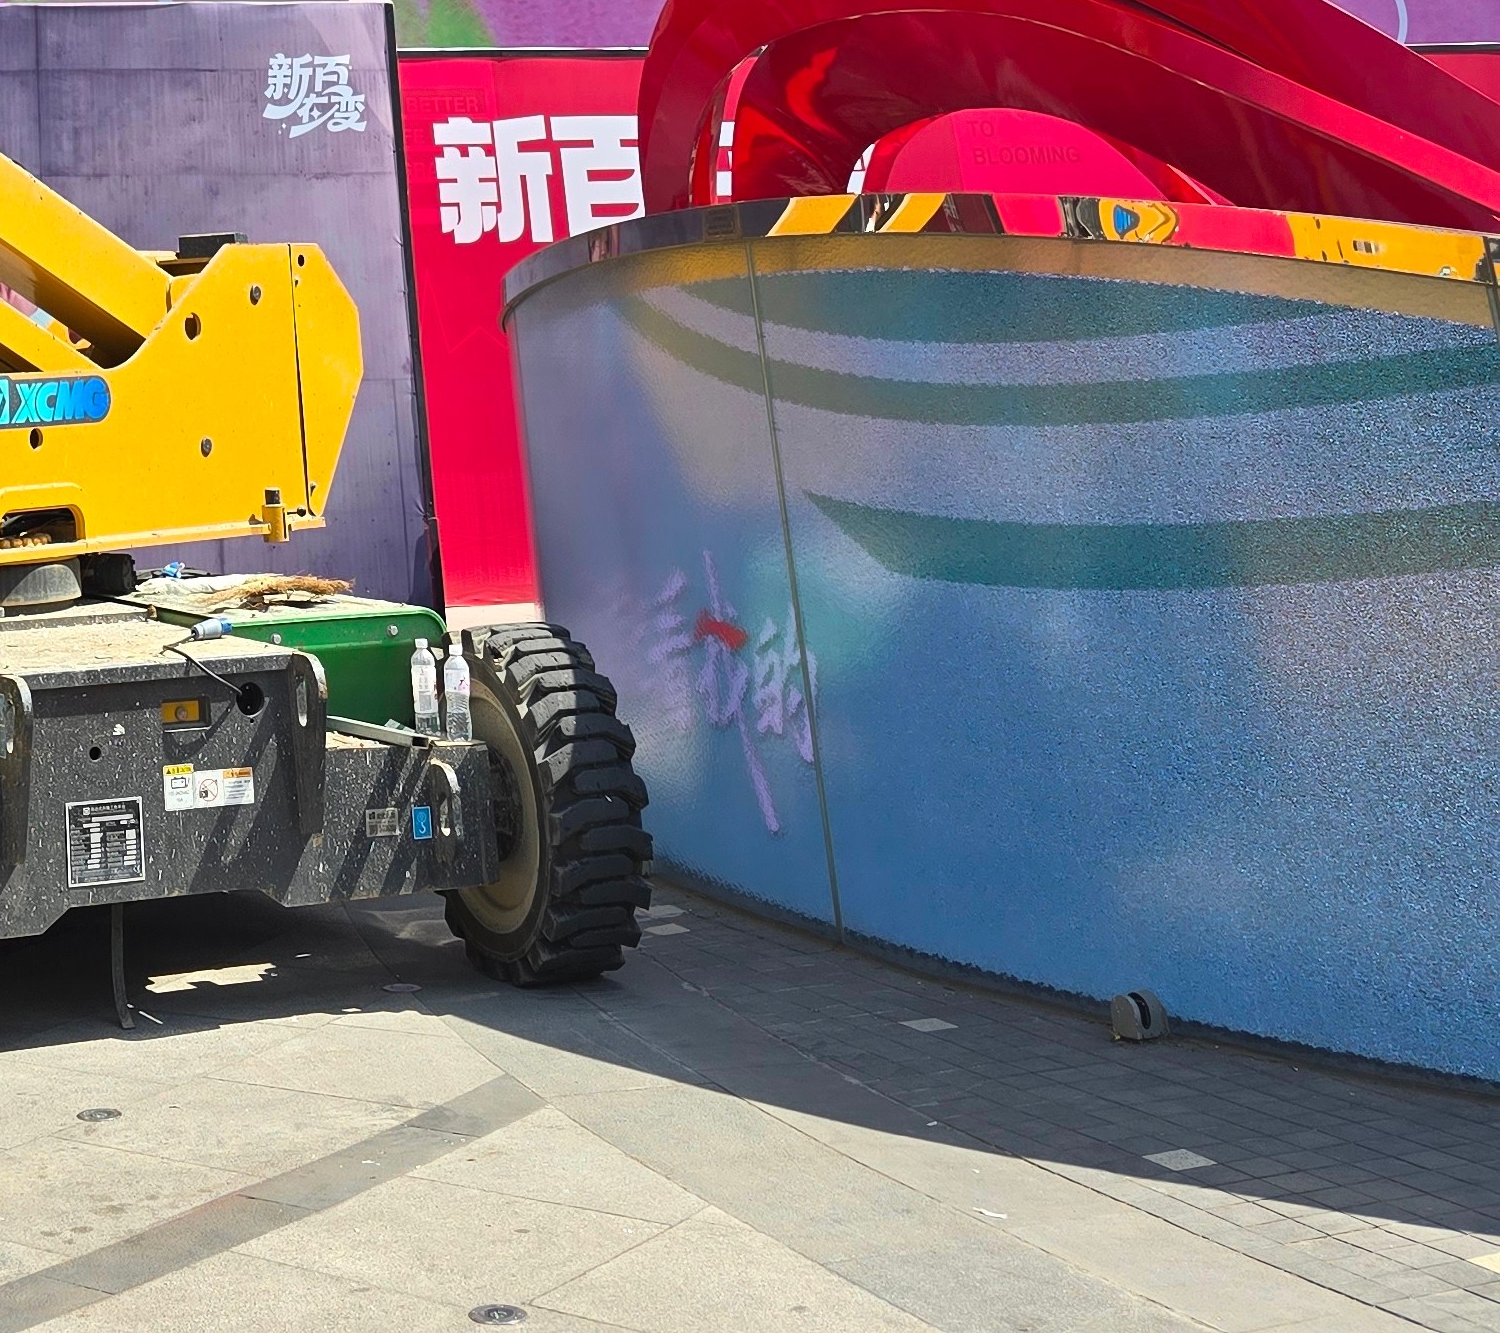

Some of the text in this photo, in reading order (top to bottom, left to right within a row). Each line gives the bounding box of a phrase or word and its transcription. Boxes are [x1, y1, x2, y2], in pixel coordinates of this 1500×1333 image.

[405, 96, 479, 113] BETTER
[966, 120, 995, 138] TO
[973, 146, 1081, 166] BLOOMING
[433, 115, 645, 244] 新百
[13, 376, 110, 424] XCMG
